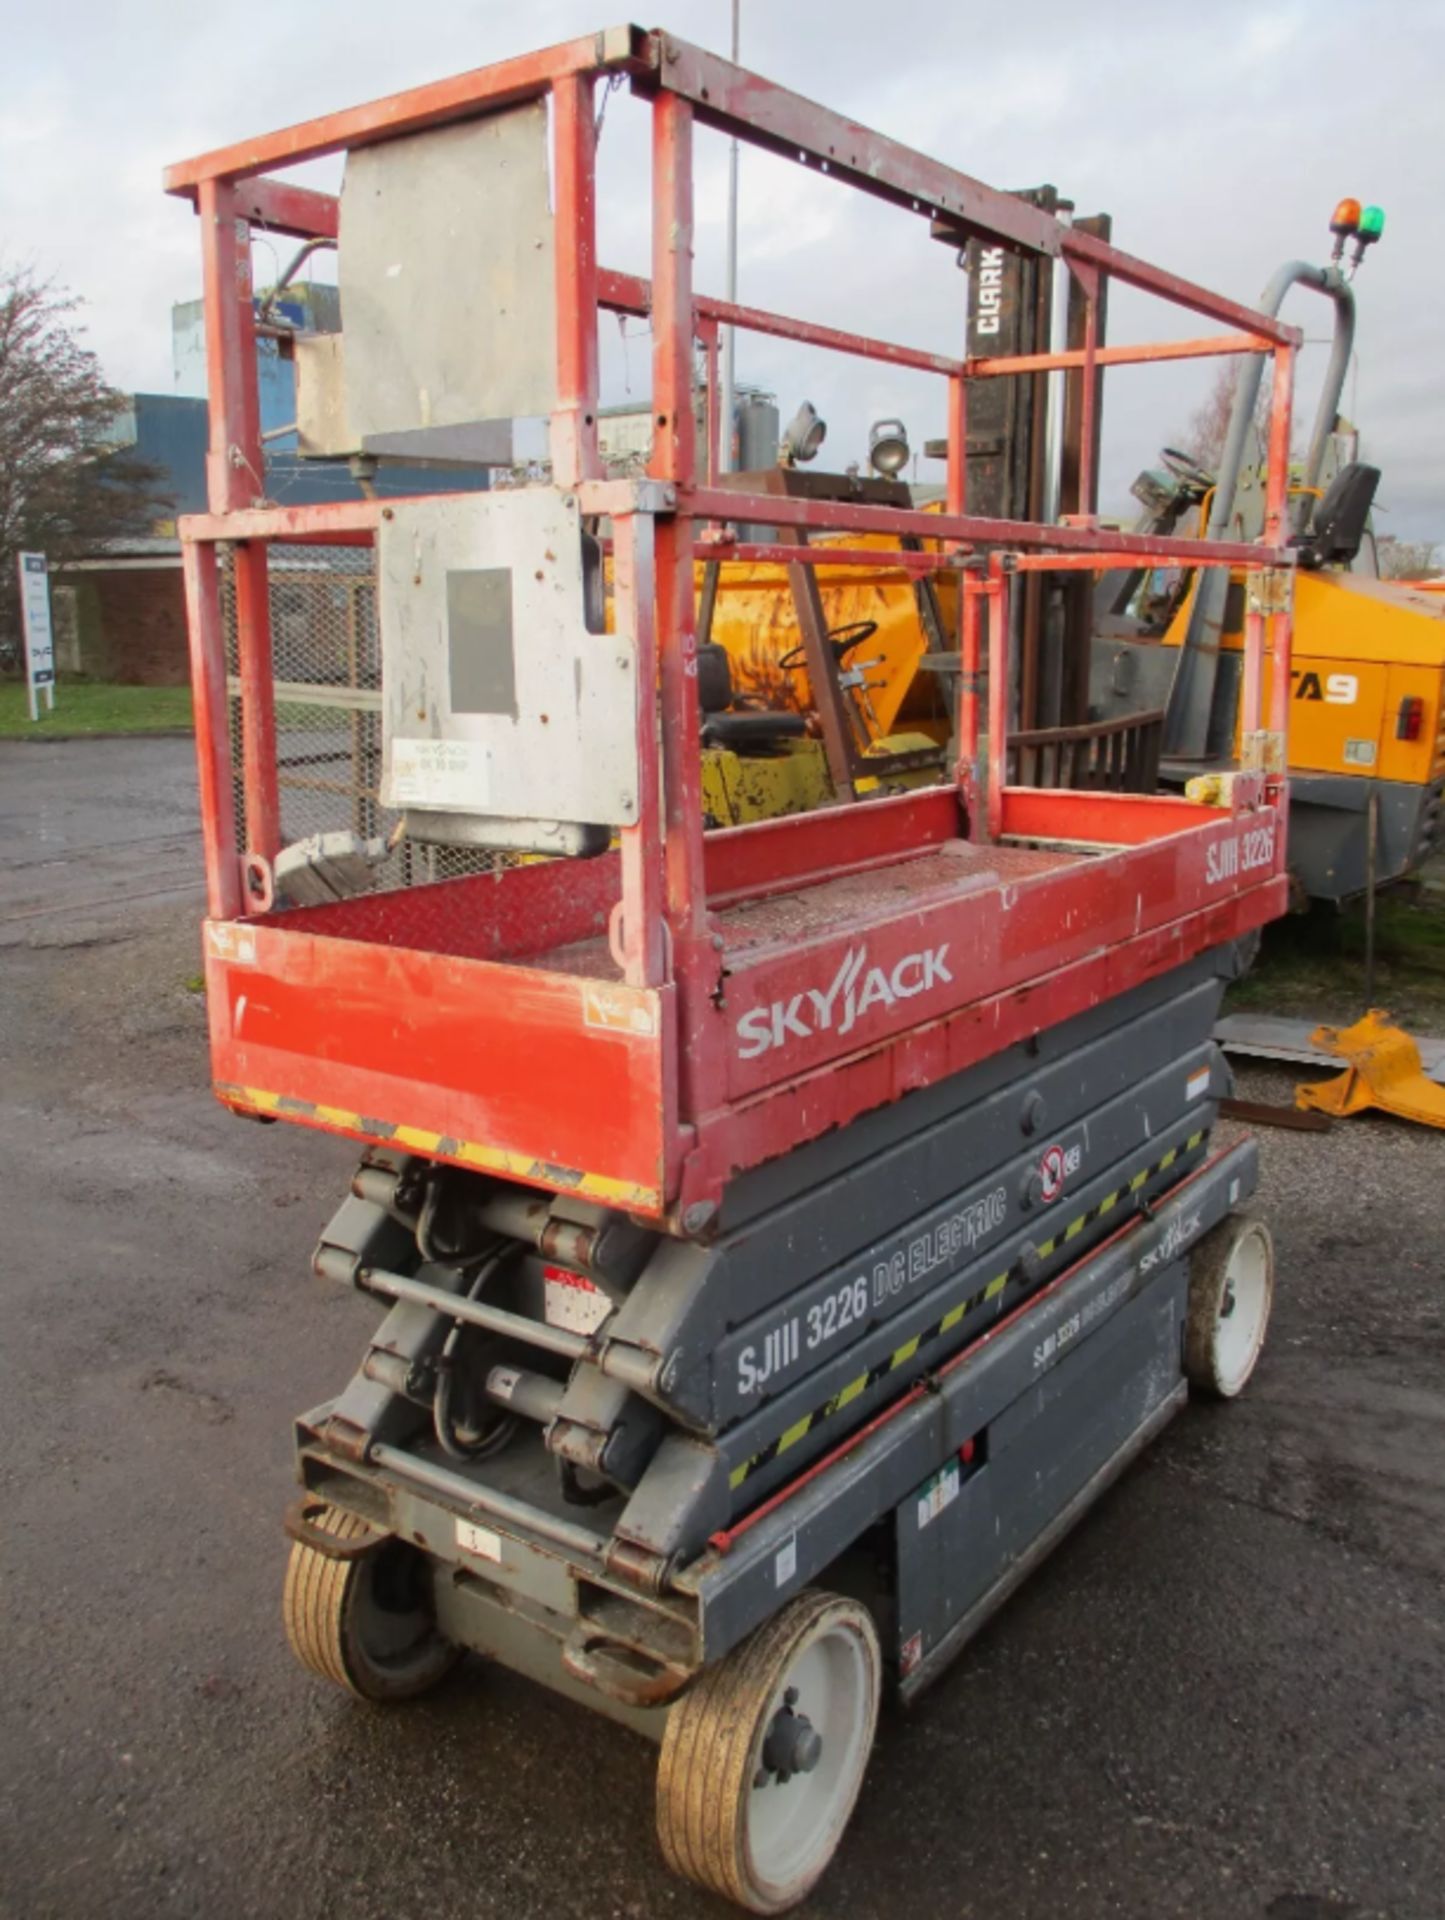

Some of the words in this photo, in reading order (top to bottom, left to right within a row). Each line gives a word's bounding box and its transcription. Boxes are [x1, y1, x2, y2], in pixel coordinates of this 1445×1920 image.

[977, 246, 1004, 334] CLARK
[1242, 826, 1274, 871] 3226
[736, 943, 953, 1059] SKYJACK
[738, 1317, 799, 1394] SJIII
[806, 1276, 868, 1349] 3226
[872, 1251, 906, 1307] DC
[908, 1187, 1007, 1283] ELECTRIC
